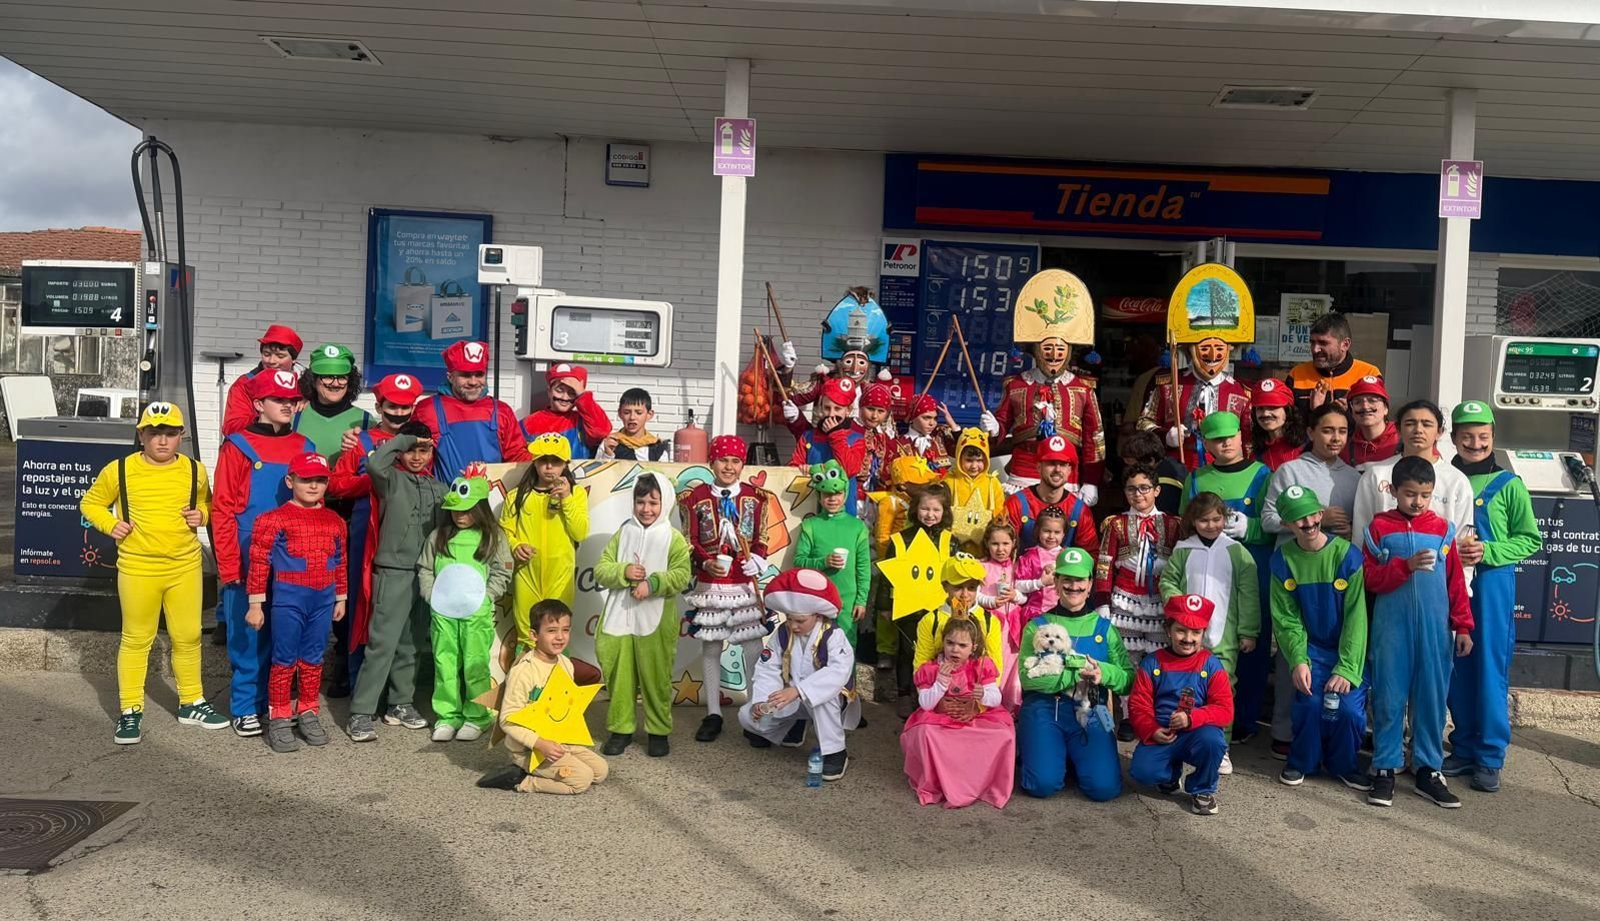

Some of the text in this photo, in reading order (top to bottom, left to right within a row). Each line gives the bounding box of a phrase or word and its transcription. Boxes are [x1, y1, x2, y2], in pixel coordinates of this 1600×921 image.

[718, 162, 751, 170] EXTINTOR
[1056, 184, 1184, 219] Tienda
[396, 231, 425, 240] Compra
[406, 256, 423, 264] 20%
[883, 261, 918, 270] Petronor
[110, 306, 122, 322] 4
[558, 332, 569, 346] 3
[1282, 334, 1310, 343] DE VE
[1580, 376, 1593, 392] 2
[1052, 438, 1062, 447] M
[22, 460, 92, 472] Ahorra en tus
[22, 474, 76, 484] repostajes
[78, 476, 88, 484] al
[22, 485, 88, 498] la luz y el ga
[22, 510, 52, 518] energías.
[1548, 518, 1564, 526] tus
[1552, 530, 1560, 539] al
[1563, 531, 1600, 540] contrat
[20, 548, 54, 557] Infórmate
[1546, 544, 1564, 553] gas
[1566, 543, 1578, 552] de
[1581, 544, 1592, 553] tu
